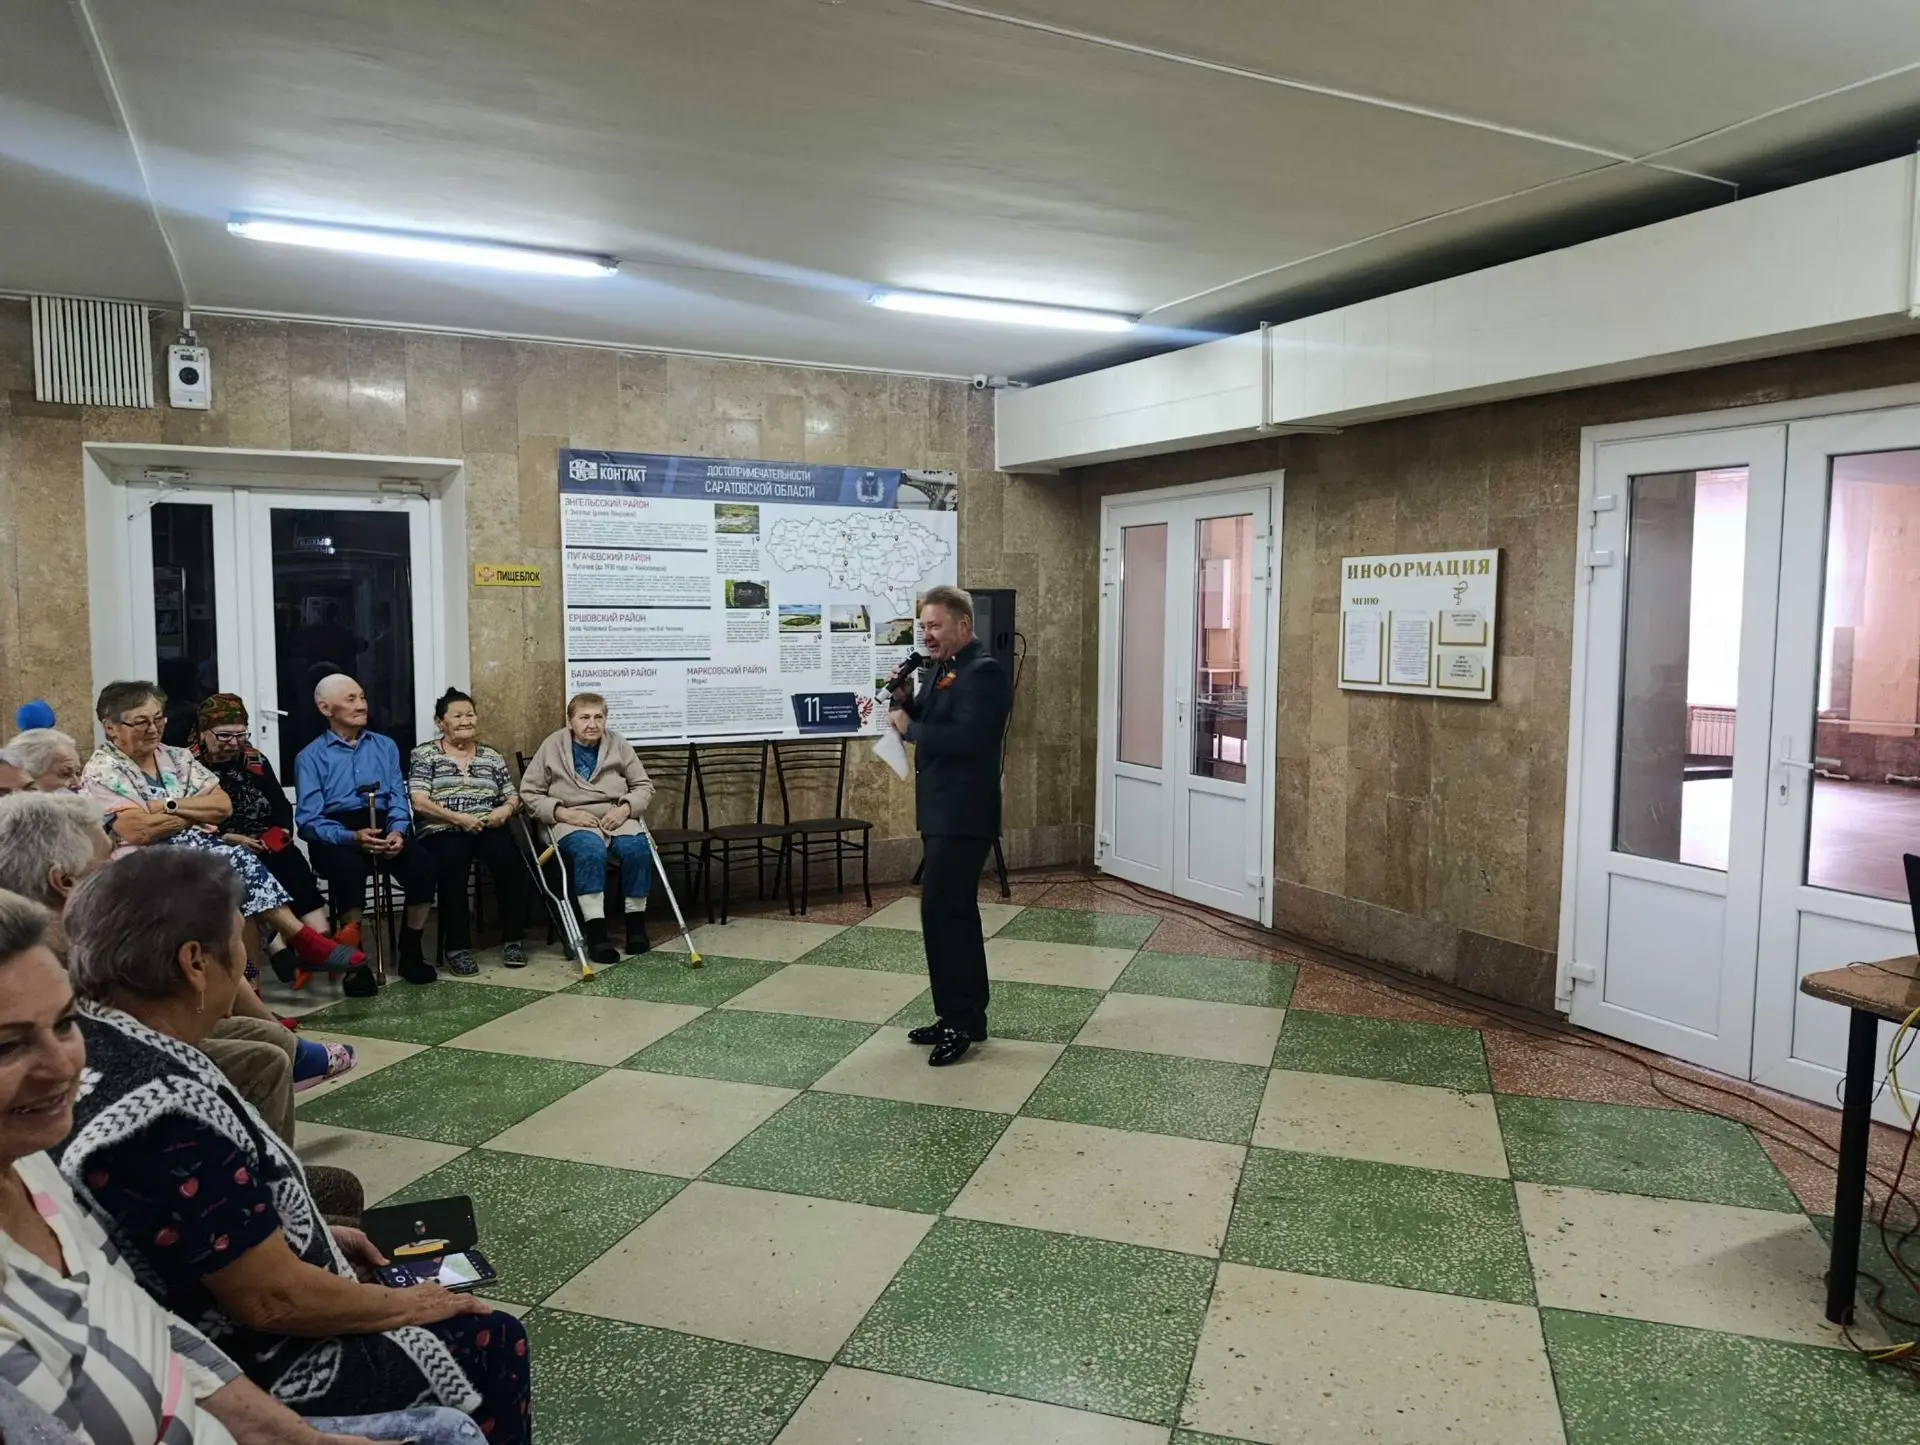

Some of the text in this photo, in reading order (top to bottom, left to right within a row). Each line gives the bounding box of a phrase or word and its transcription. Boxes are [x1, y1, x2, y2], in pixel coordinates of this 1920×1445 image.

[600, 467, 646, 482] КОНТАКТ
[706, 465, 811, 481] ДОСТОПРИМЕЧАТЕЛЬНОСТИ
[705, 481, 815, 498] САРАТОВСКОЙ ОБЛАСТИ
[565, 497, 650, 509] ЭНГЕЛЬССКИЙ РАЙОН
[567, 551, 652, 562] ПУГАЧЕВСКИЙ РАЙОН
[1347, 559, 1491, 579] ИНФОРМАЦИЯ
[496, 570, 540, 583] ПИЩЕБЛОК
[1352, 597, 1379, 605] МЕНЮ
[568, 613, 646, 623] ЕРШОВСКИЙ РАЙОН
[571, 667, 657, 678] БАЛАКОВСКИЙ РАЙОН
[687, 665, 767, 675] МАРКСОВСКИЙ РАЙОН
[804, 697, 820, 722] 11
